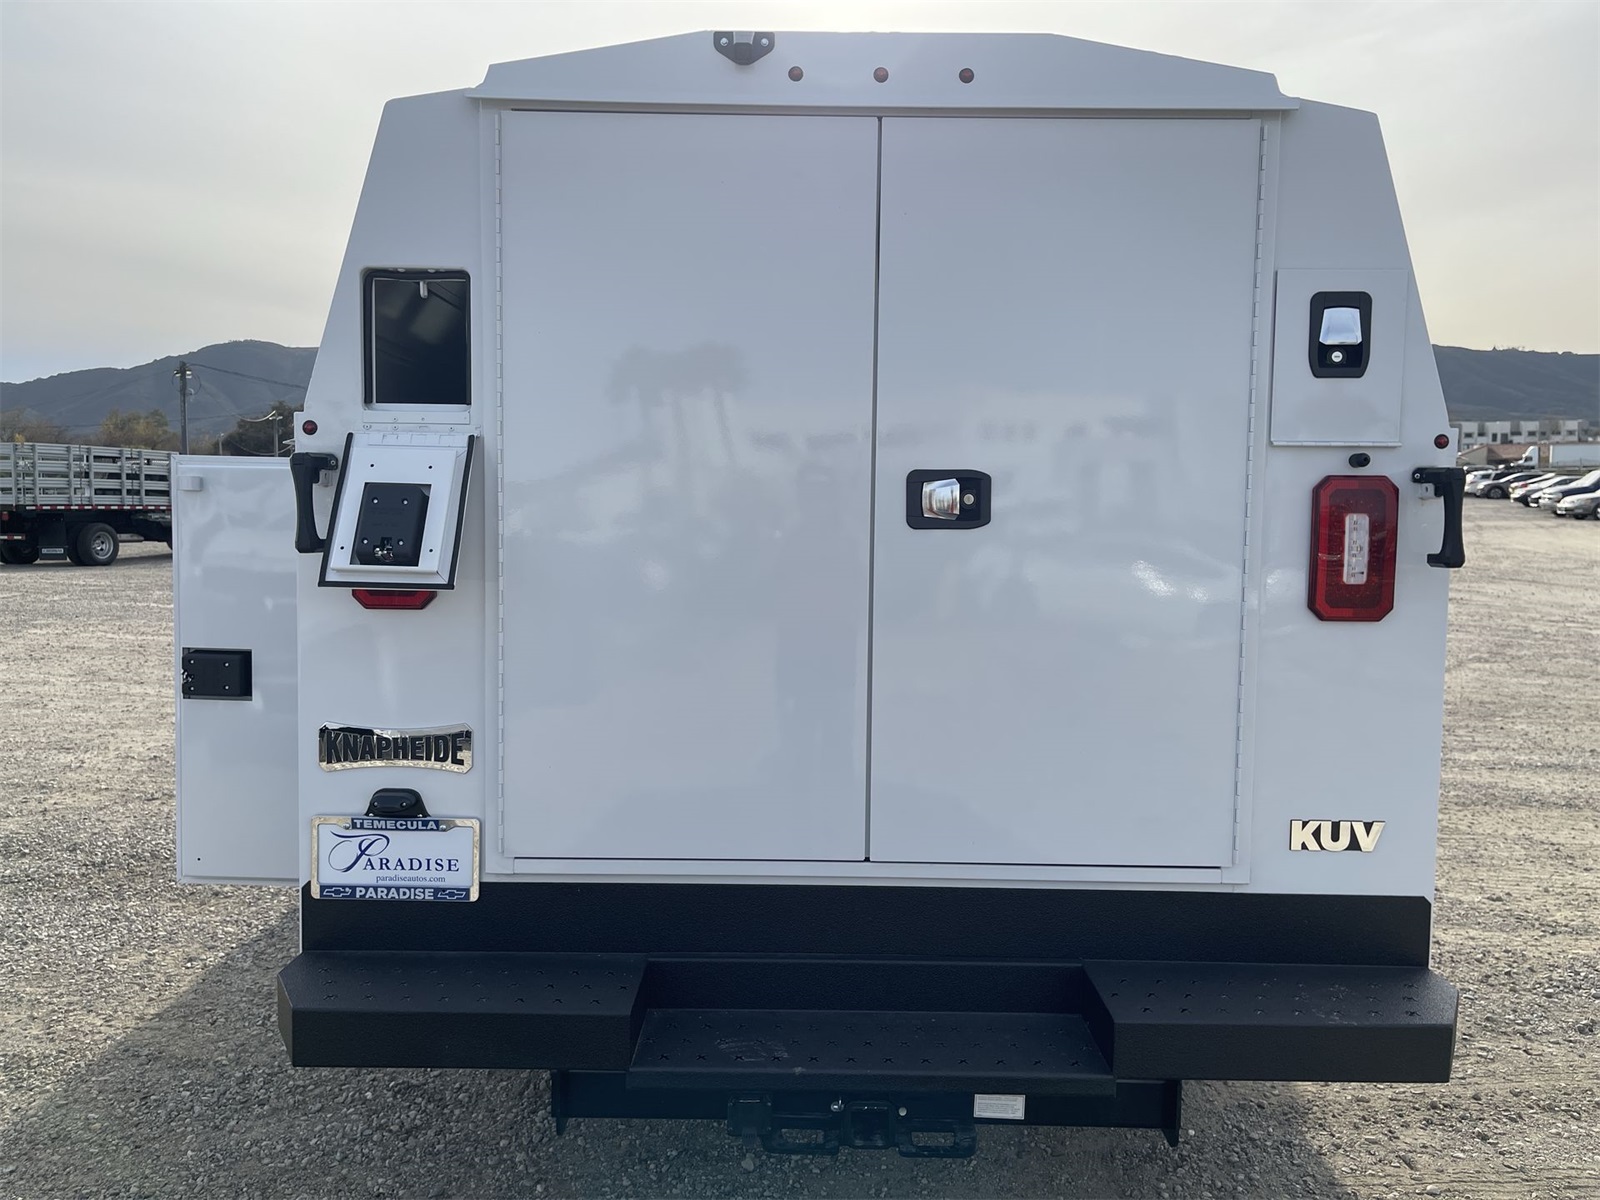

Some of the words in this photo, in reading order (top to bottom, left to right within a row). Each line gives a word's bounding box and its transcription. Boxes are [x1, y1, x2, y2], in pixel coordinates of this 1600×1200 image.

[326, 730, 465, 766] KNAPHEIDE
[353, 819, 437, 830] TEMECULA
[1289, 819, 1386, 852] KUV
[328, 831, 460, 873] PARADISE
[375, 874, 446, 883] paradiseautos.com
[355, 887, 434, 900] PARADISE
